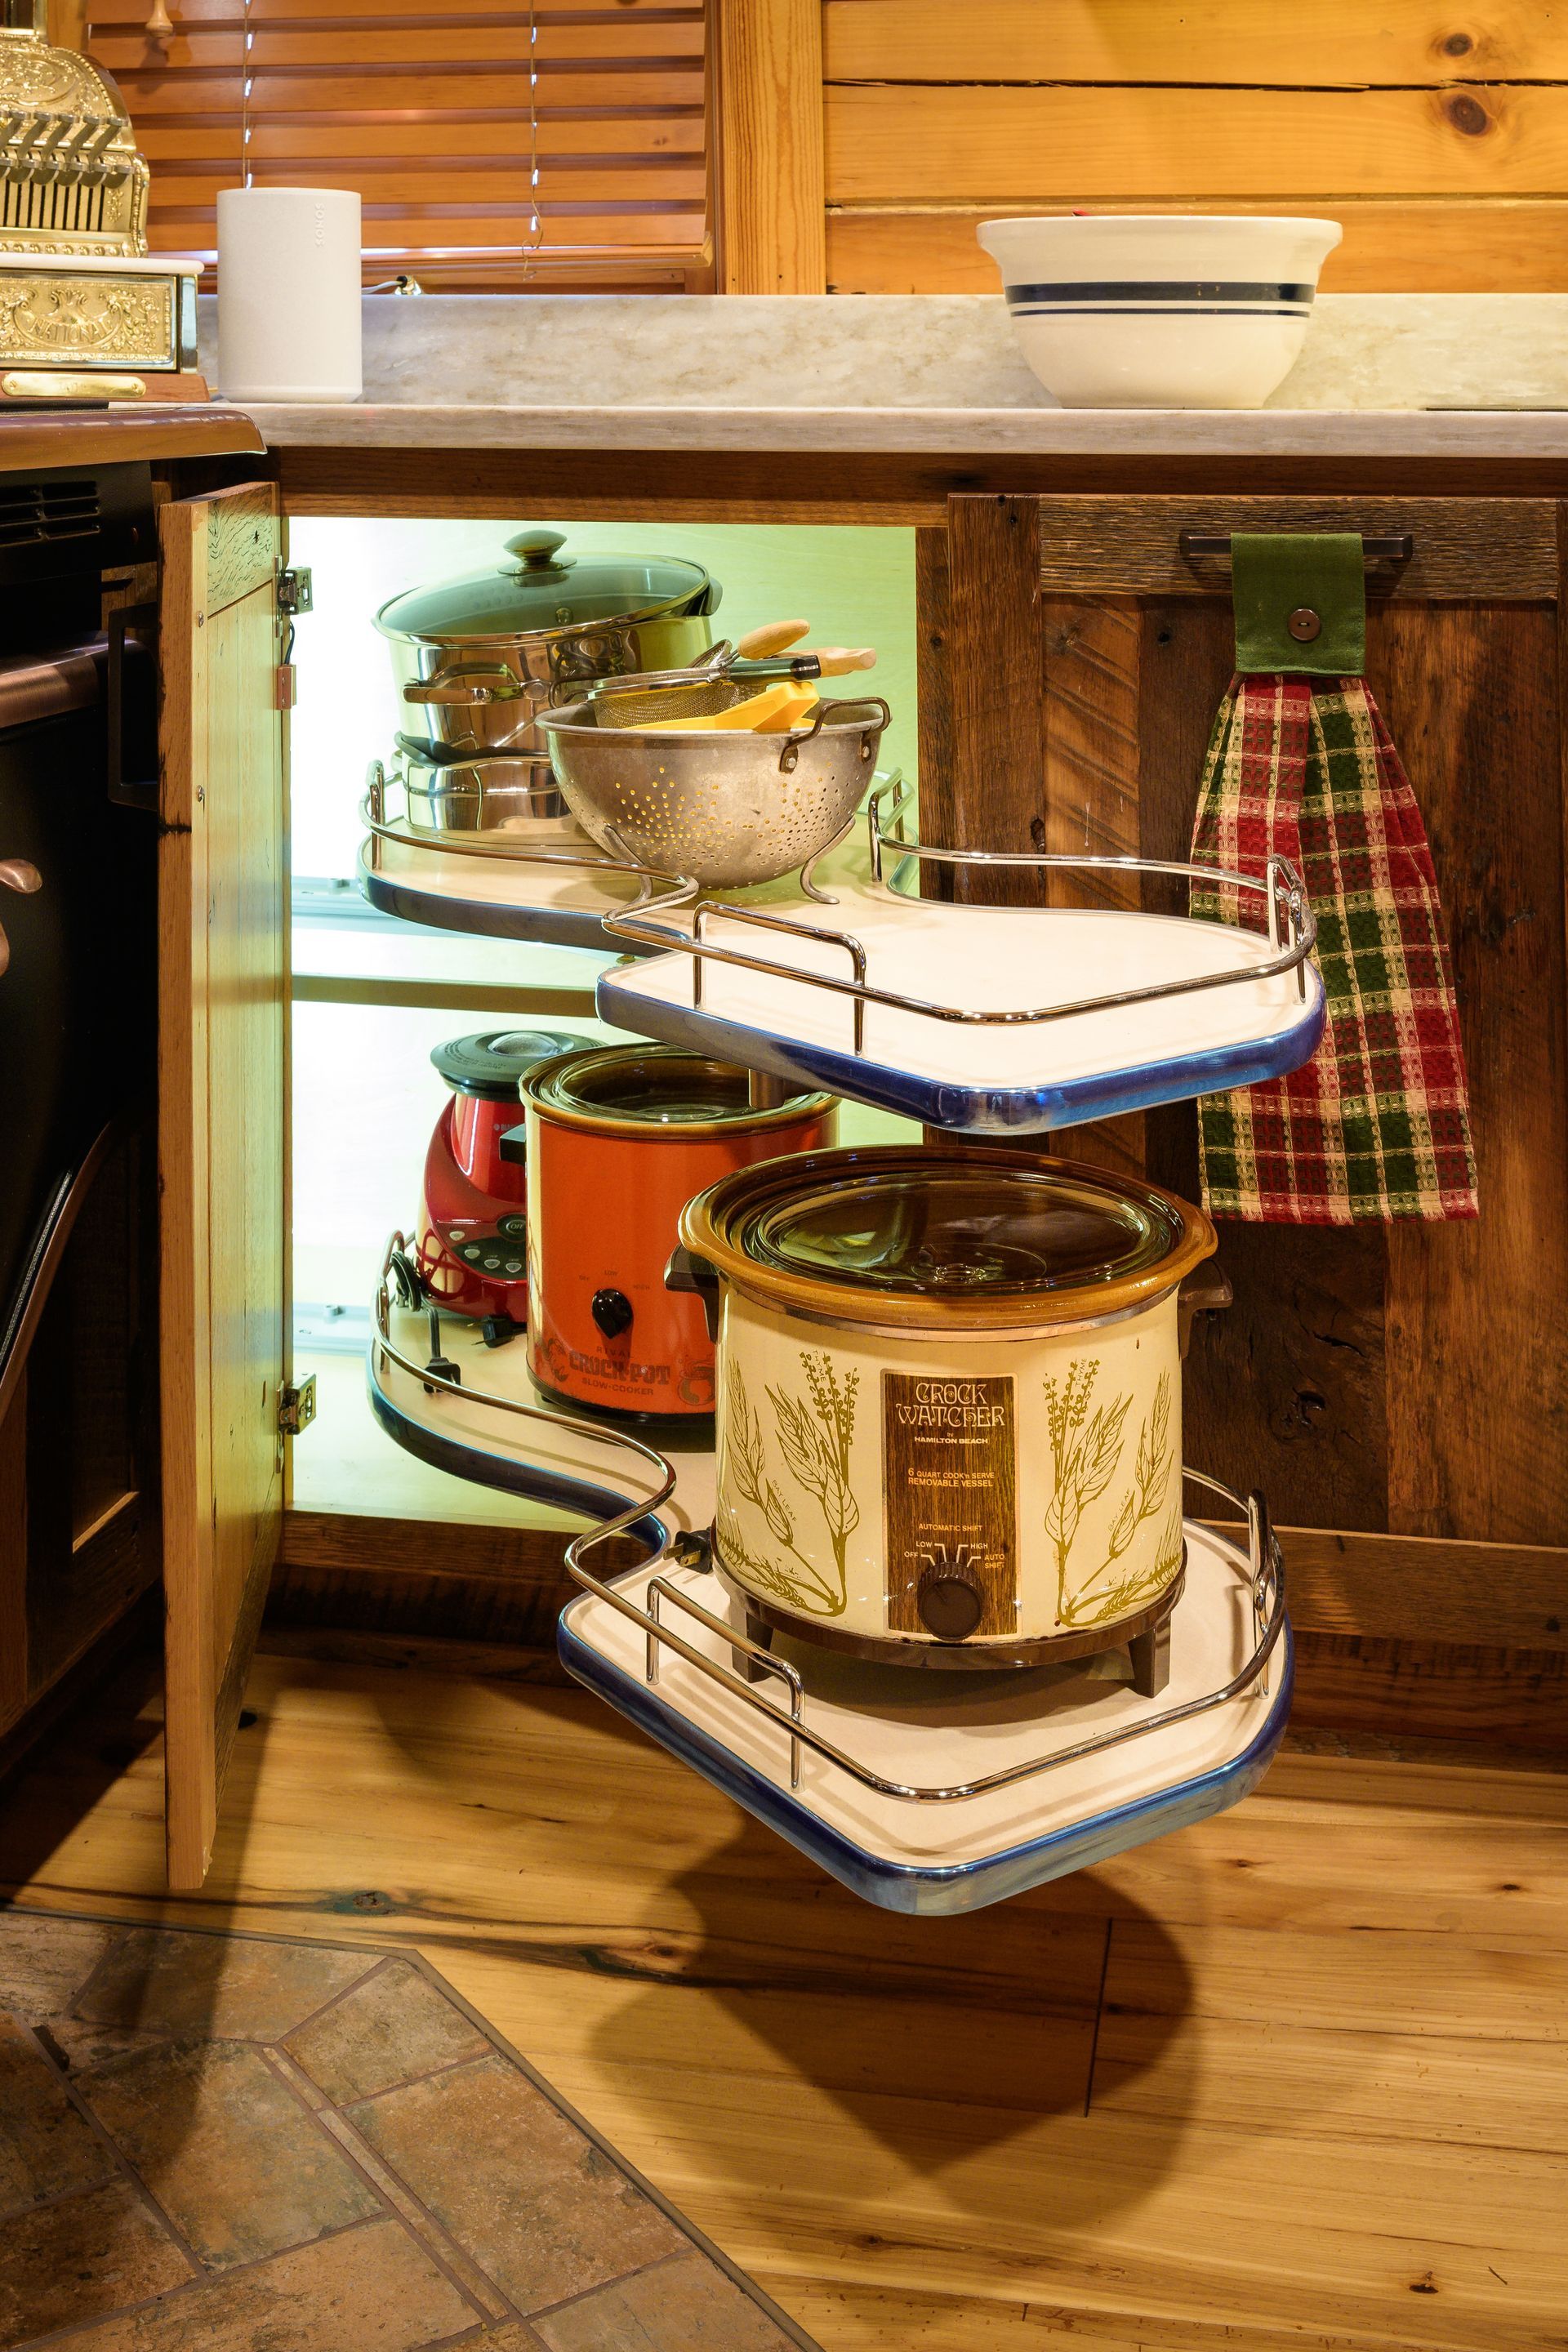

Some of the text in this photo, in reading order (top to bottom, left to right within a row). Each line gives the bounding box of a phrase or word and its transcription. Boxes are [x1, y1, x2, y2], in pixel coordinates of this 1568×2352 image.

[314, 203, 325, 247] SONOS
[28, 318, 112, 344] NATIONAL
[813, 1350, 826, 1382] THYME
[1076, 1358, 1087, 1387] THYME
[915, 1383, 987, 1405] CROCK
[895, 1403, 1005, 1428] WATCHER
[908, 1468, 915, 1477] 6
[916, 1470, 941, 1478] QUART
[908, 1477, 993, 1487] REMOVABLE VESSEL
[772, 1479, 797, 1522] BAY LEAF
[919, 1523, 961, 1531] AUTOMATIC
[915, 1540, 933, 1548] LOW
